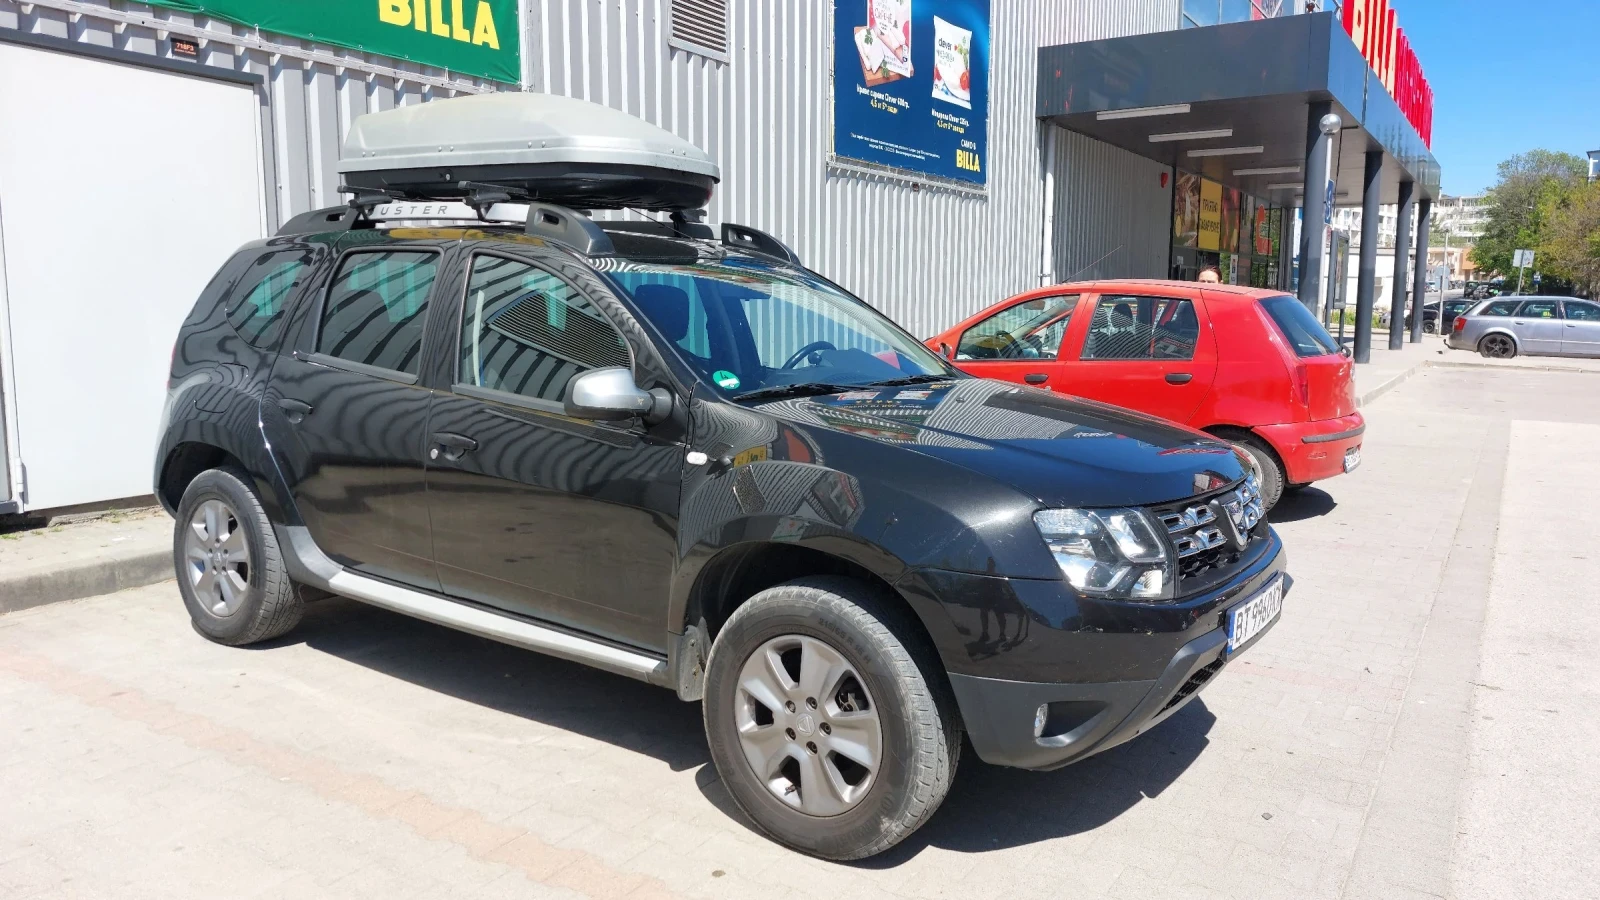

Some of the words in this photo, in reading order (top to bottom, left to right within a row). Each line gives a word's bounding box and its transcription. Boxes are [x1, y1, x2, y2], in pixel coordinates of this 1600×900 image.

[378, 0, 500, 50] BILLA
[956, 149, 980, 172] BILLA
[380, 206, 448, 216] USTER
